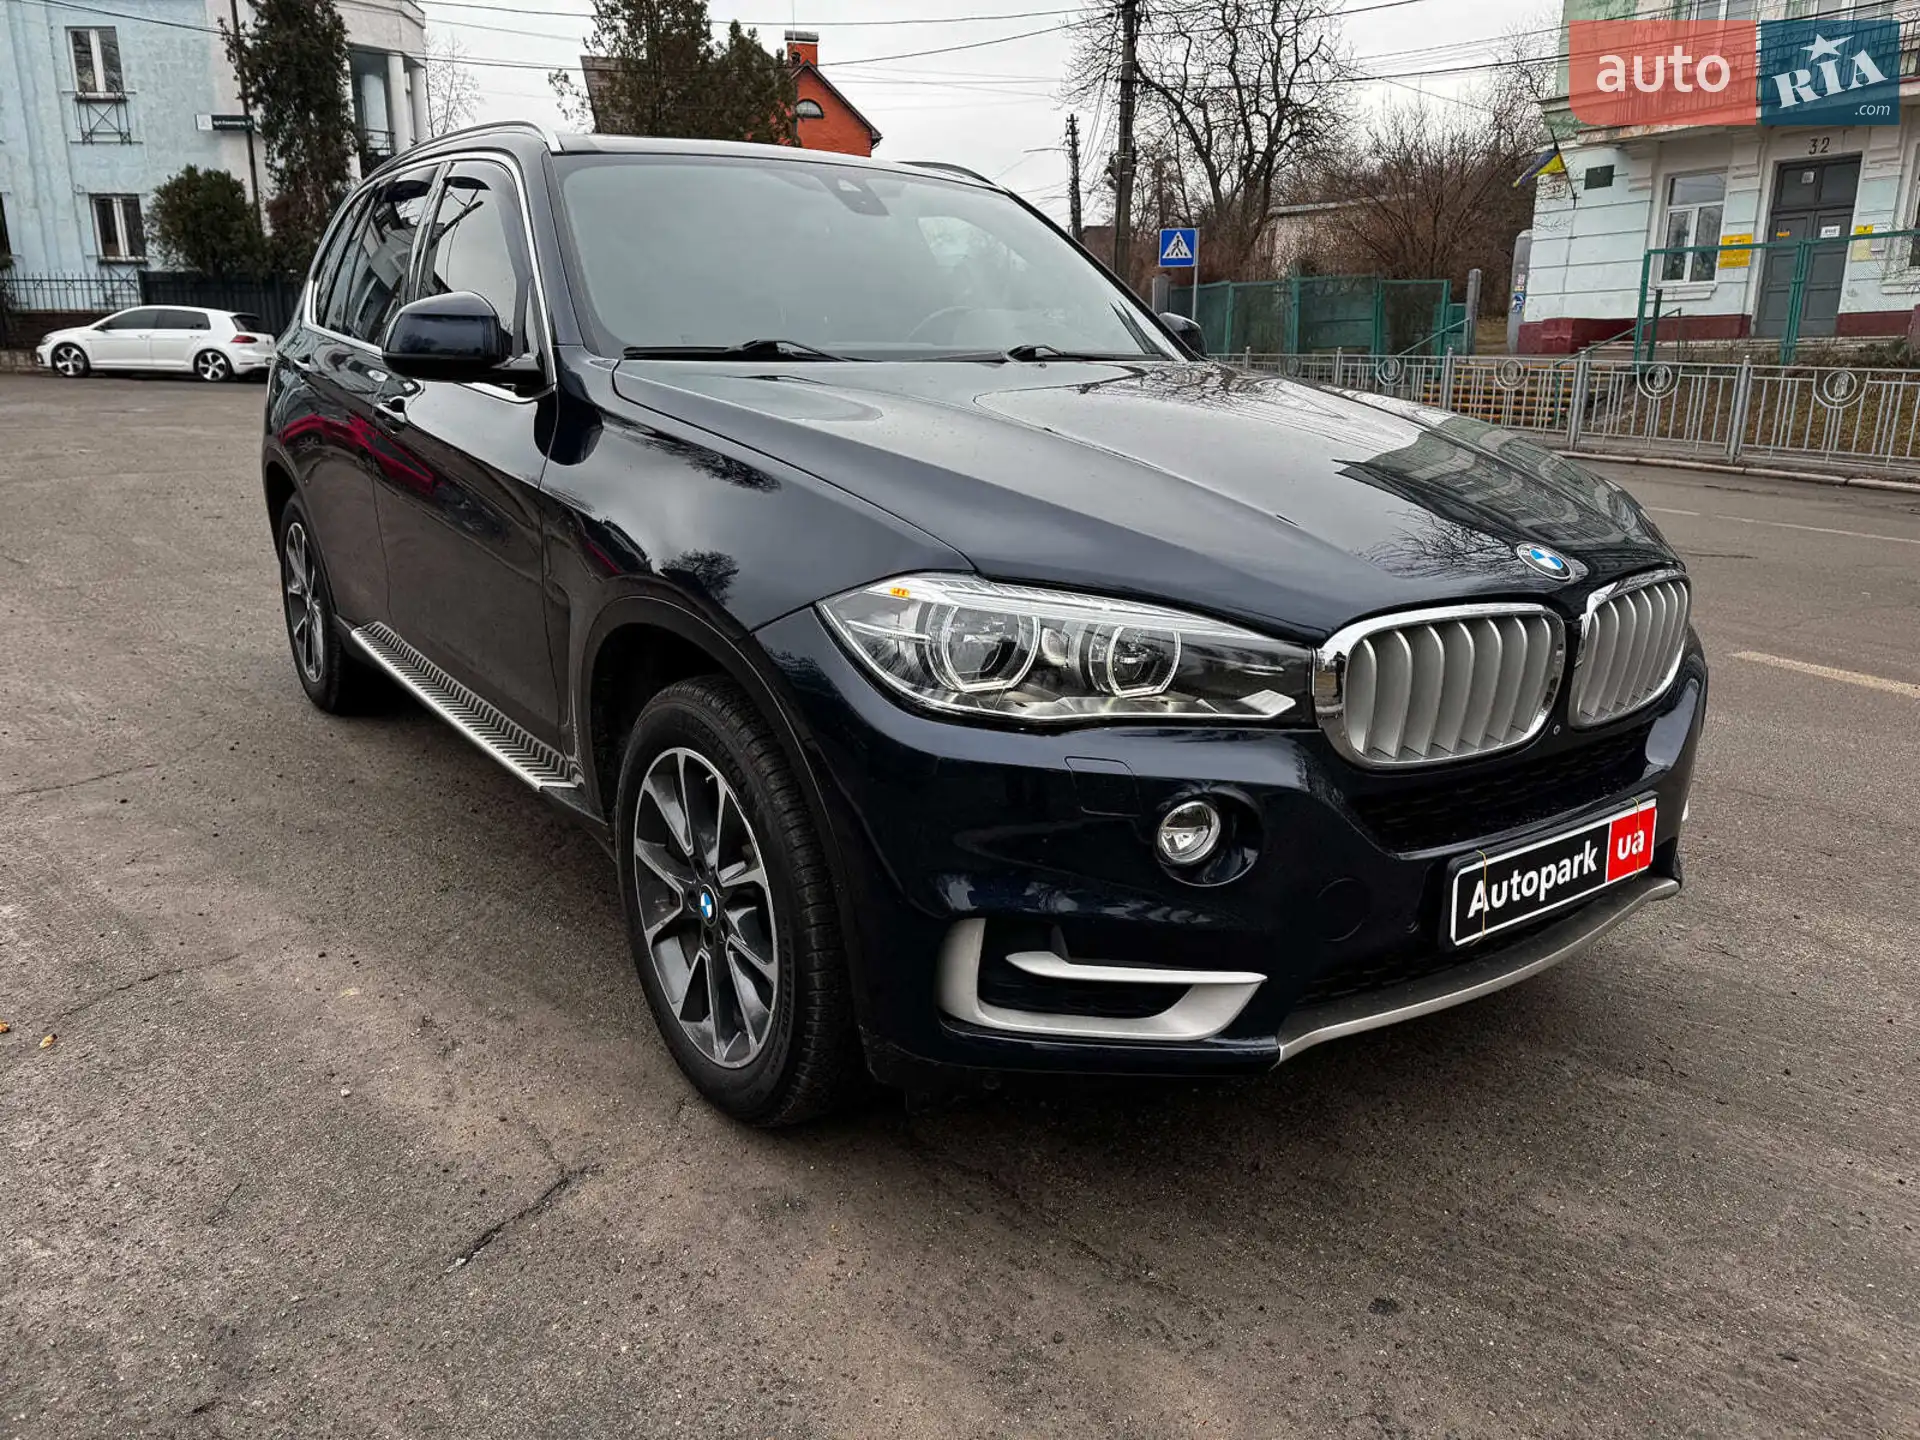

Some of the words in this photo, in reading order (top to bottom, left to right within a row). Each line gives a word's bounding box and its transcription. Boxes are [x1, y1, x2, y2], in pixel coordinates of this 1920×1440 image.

[1808, 136, 1831, 155] 32
[1467, 840, 1599, 919] Autopark
[1616, 828, 1645, 861] ua
